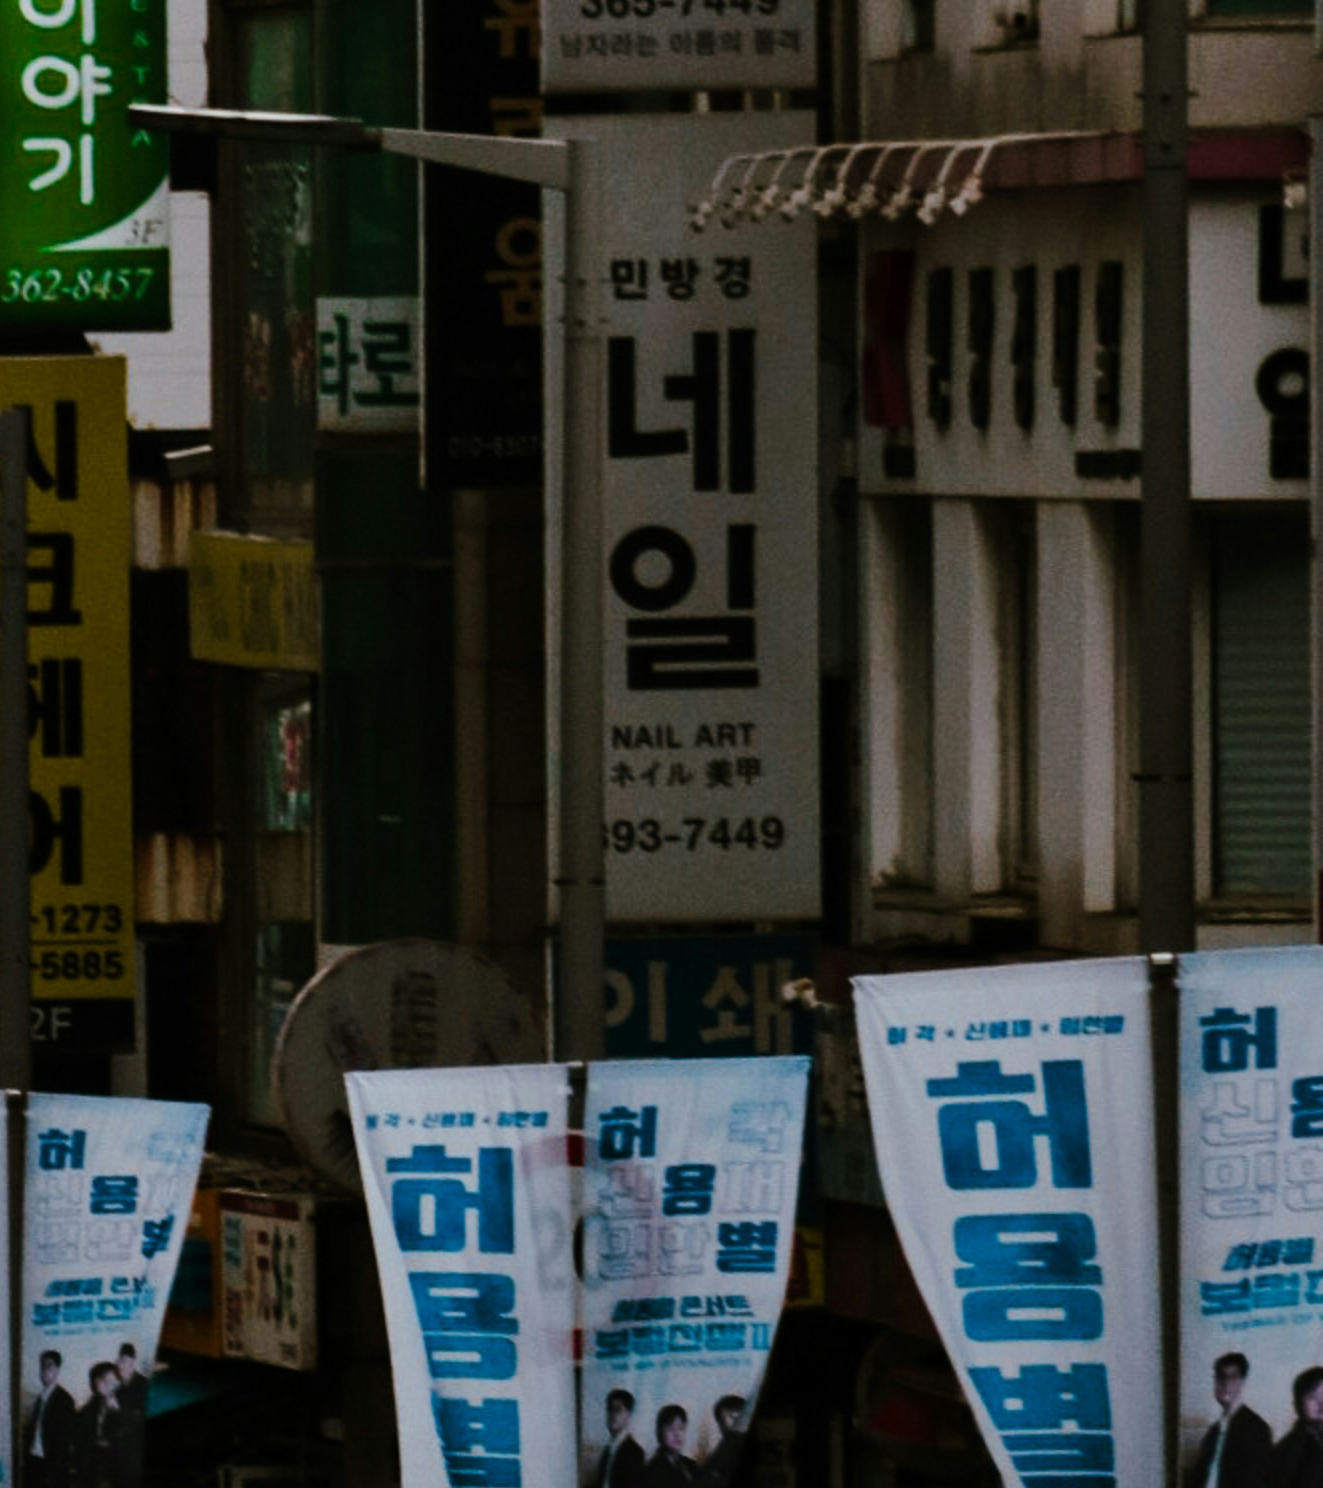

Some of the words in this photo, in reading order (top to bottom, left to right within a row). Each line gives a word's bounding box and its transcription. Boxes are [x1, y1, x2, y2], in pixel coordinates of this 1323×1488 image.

[0, 264, 155, 306] 362-8457
[319, 313, 420, 416] 타로
[607, 326, 759, 692] 네일
[612, 724, 683, 750] NAIL
[695, 723, 756, 749] ART
